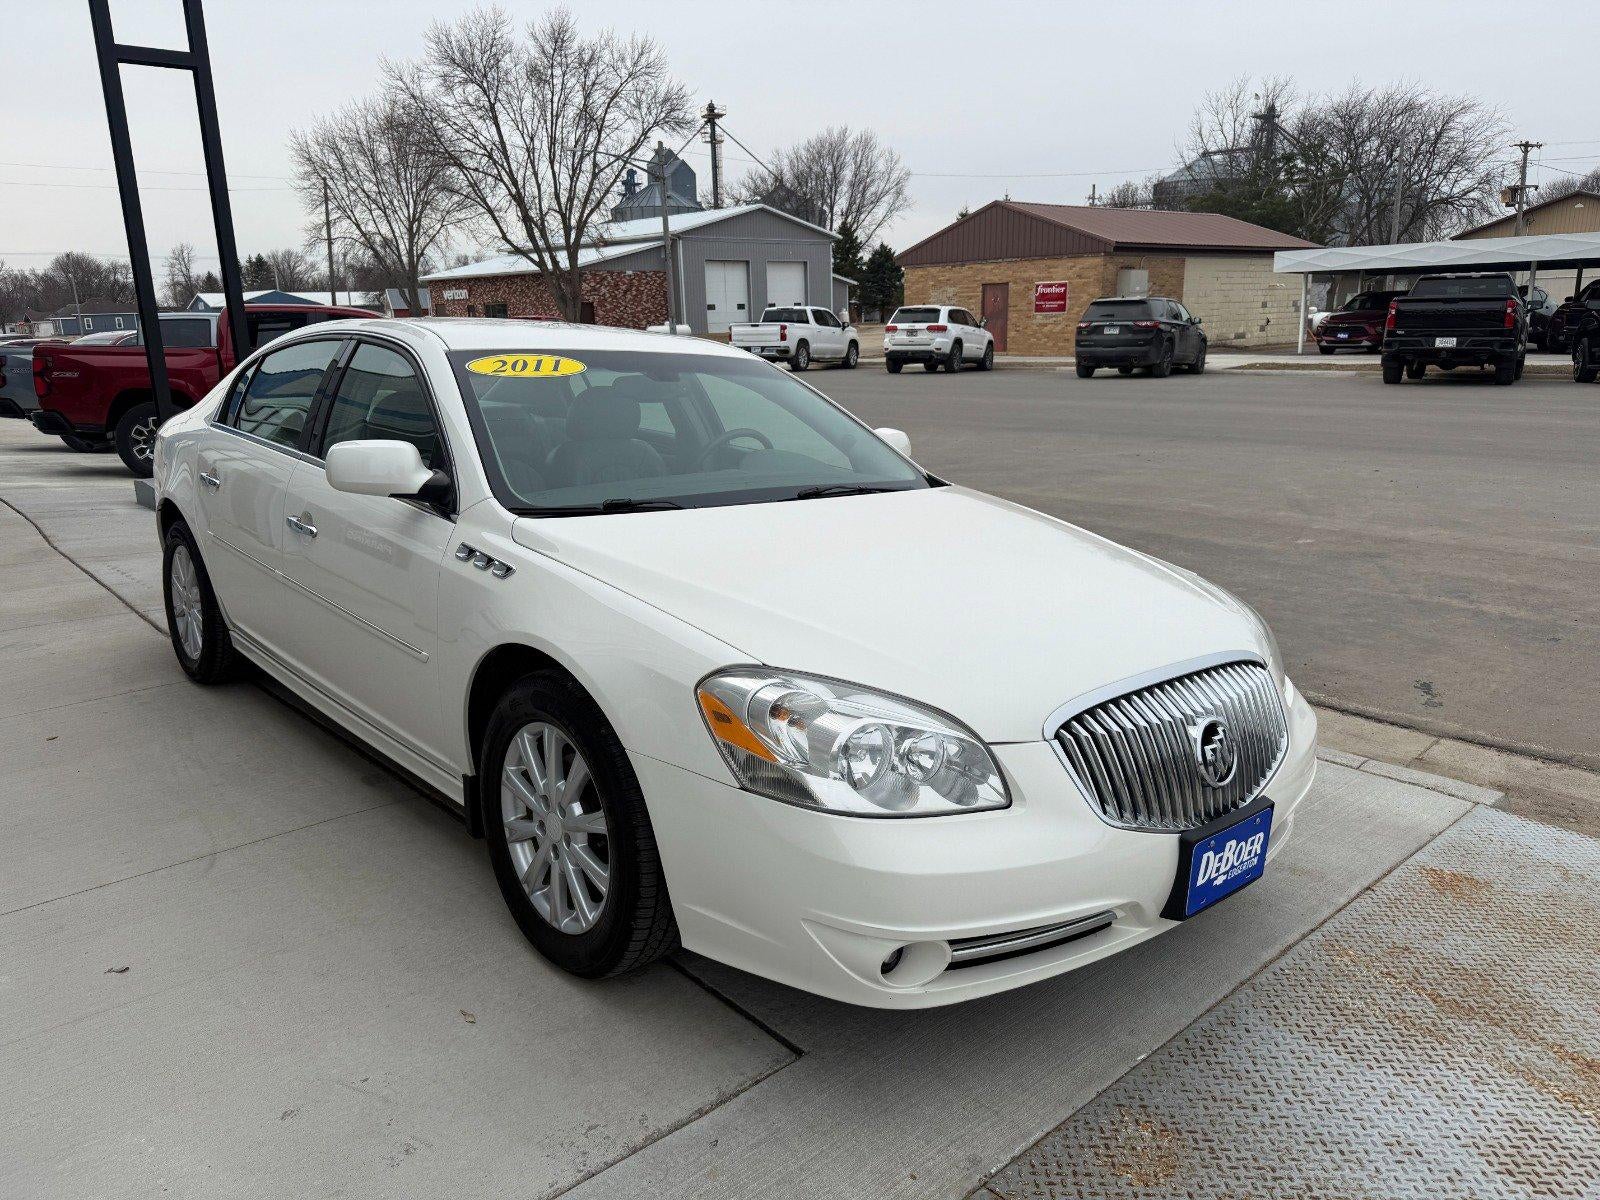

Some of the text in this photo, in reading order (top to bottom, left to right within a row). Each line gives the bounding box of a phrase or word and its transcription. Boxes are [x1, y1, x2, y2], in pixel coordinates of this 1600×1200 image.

[443, 287, 469, 300] verizon
[1035, 285, 1065, 296] frontier
[491, 359, 562, 374] 2011
[1227, 856, 1259, 879] EDGERTON
